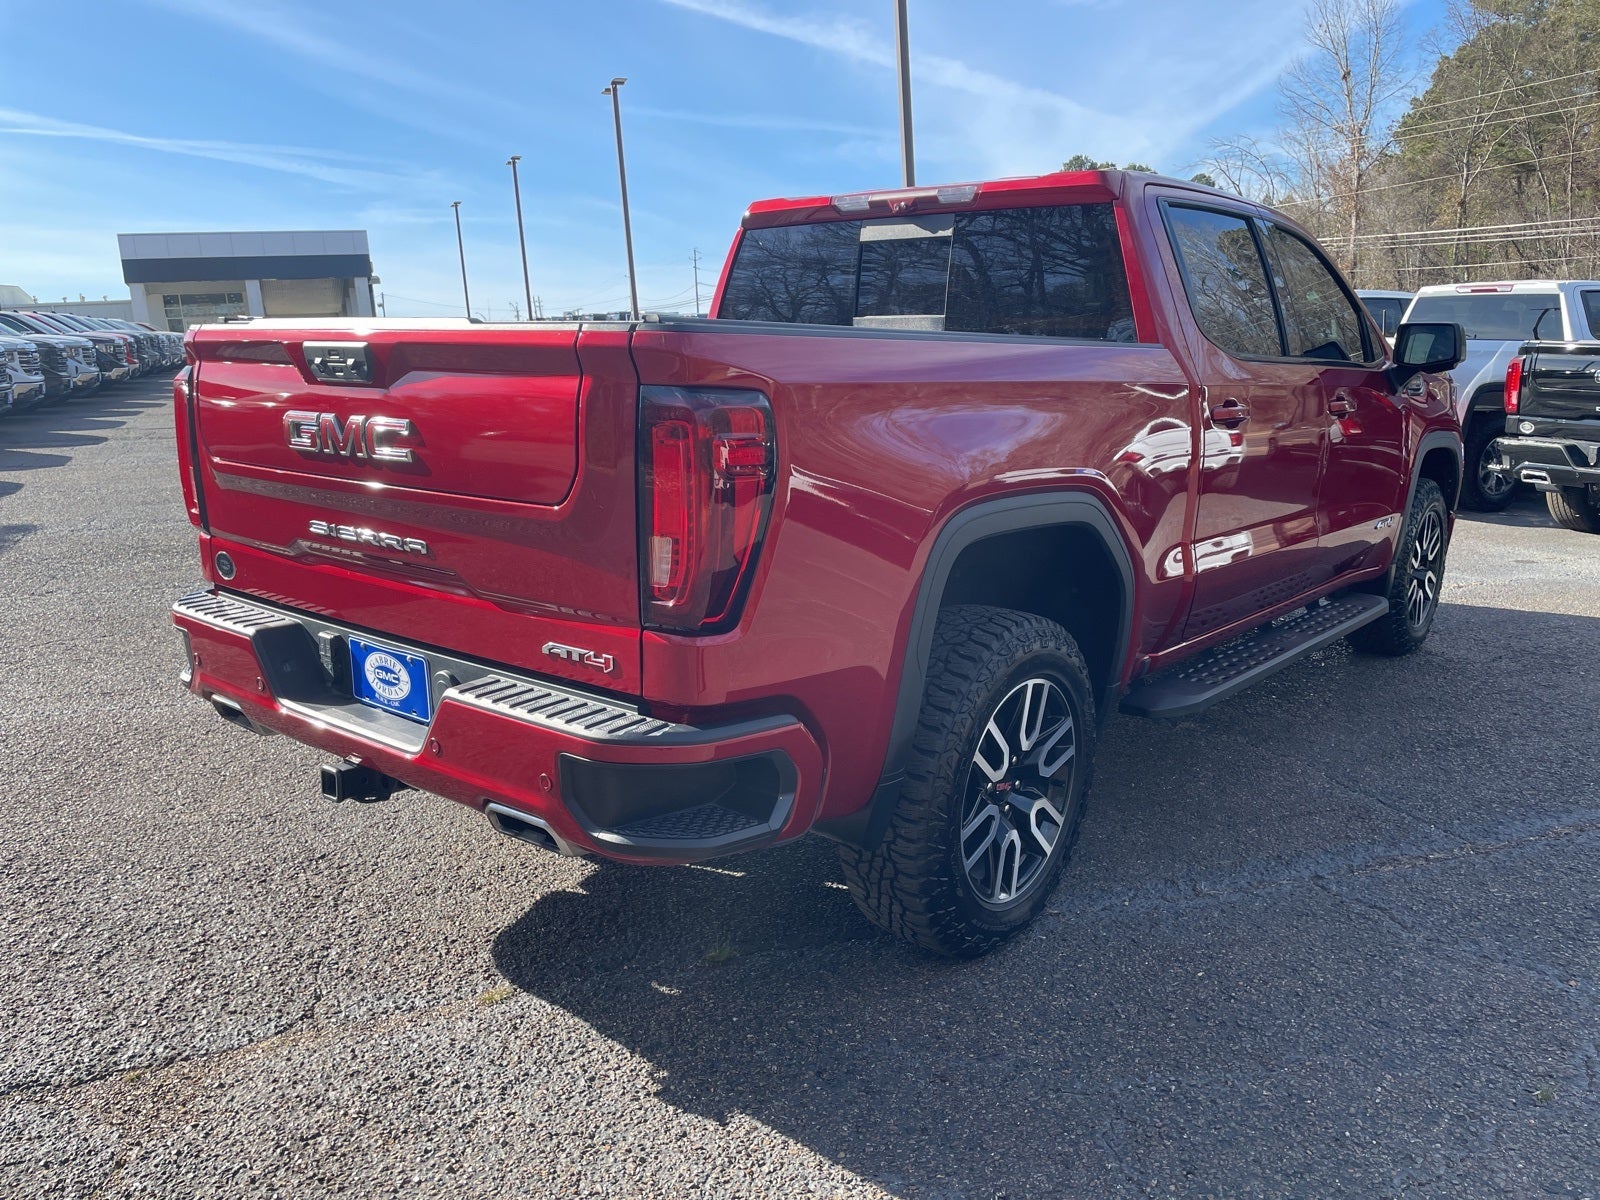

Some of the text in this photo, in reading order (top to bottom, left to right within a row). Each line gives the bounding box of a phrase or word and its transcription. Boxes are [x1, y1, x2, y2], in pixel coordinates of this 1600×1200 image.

[283, 410, 412, 462] GMC
[309, 520, 427, 554] SIERRA
[370, 656, 404, 673] GABRIEL
[542, 641, 613, 673] AT4
[371, 677, 405, 697] JORDAN
[375, 668, 399, 684] GMC
